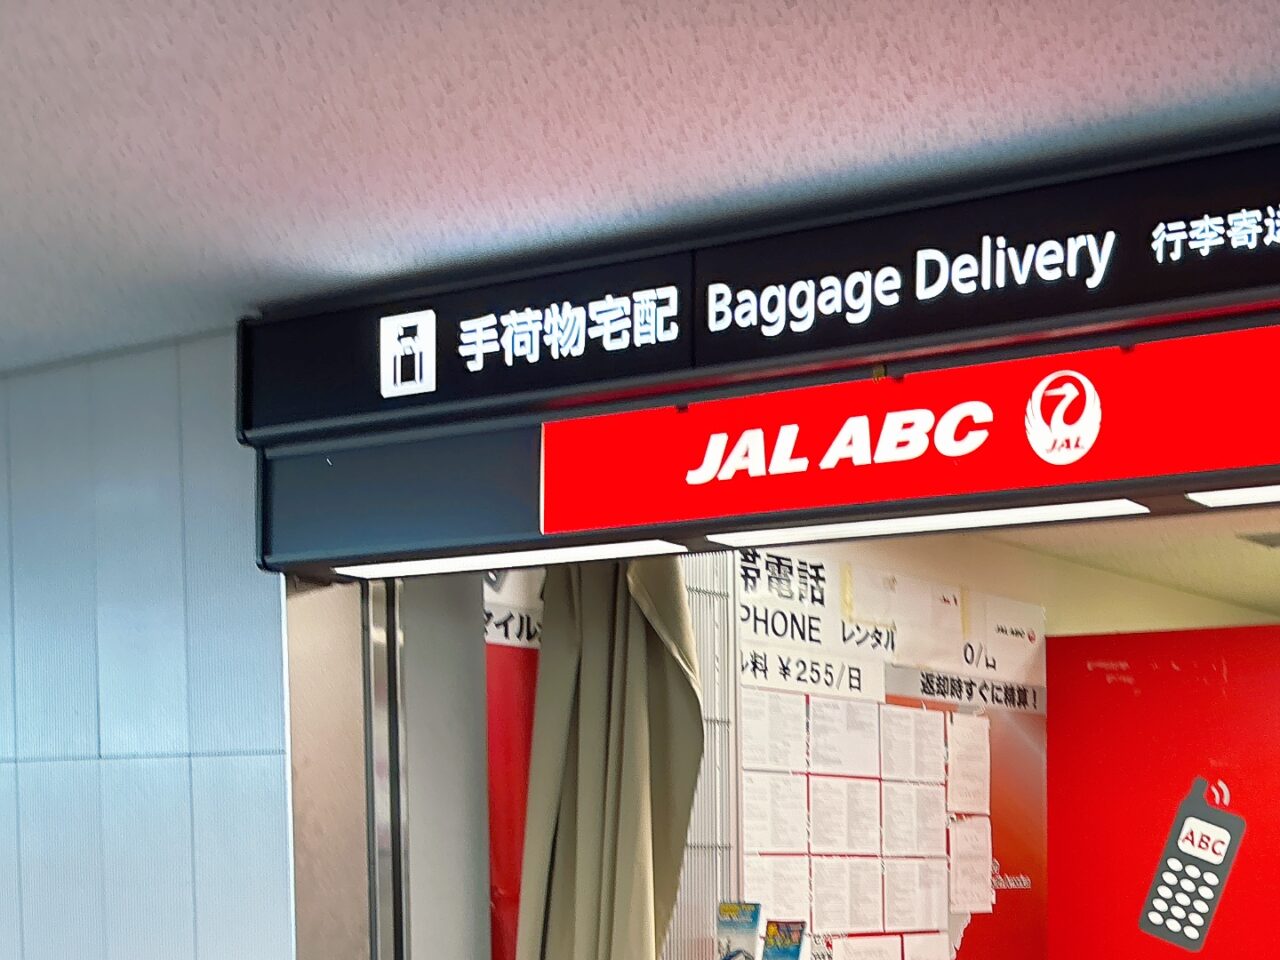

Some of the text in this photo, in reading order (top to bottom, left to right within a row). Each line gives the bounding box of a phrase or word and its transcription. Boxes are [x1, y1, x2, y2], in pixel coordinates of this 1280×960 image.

[707, 230, 1117, 338] Baggage Delivery
[457, 285, 679, 373] 手荷物宅配
[685, 401, 994, 485] JAL ABC
[1045, 436, 1086, 454] JAL
[1181, 829, 1226, 857] ABC
